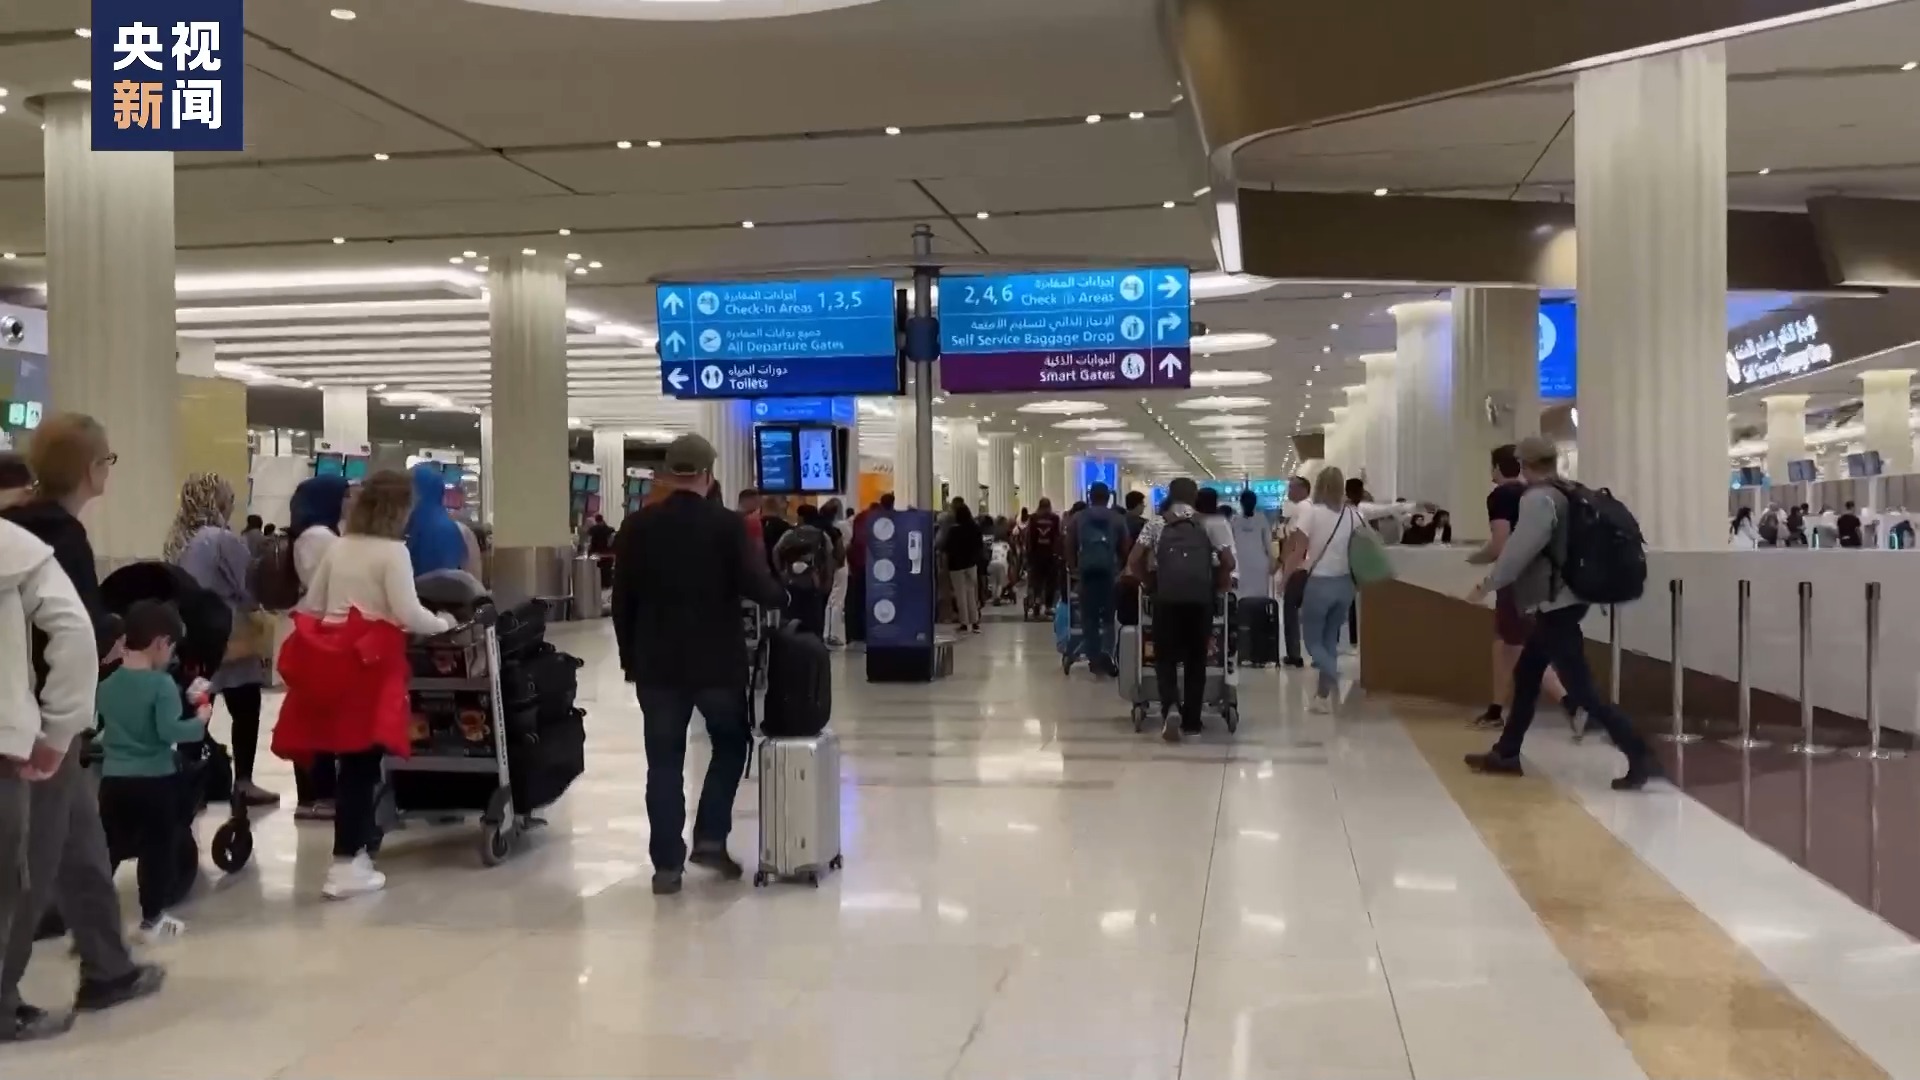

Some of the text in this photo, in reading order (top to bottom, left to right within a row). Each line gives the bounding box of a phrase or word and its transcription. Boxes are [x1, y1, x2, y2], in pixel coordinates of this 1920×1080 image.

[817, 291, 862, 311] 1,3,5
[1079, 292, 1114, 304] Areas
[724, 303, 813, 315] Check-In Areas
[951, 330, 1115, 347] Self Service Baggage Drop
[727, 339, 844, 354] All Departure Gates
[757, 364, 788, 377] دورات
[1040, 369, 1115, 382] Smart Gates
[728, 377, 769, 390] Toilets
